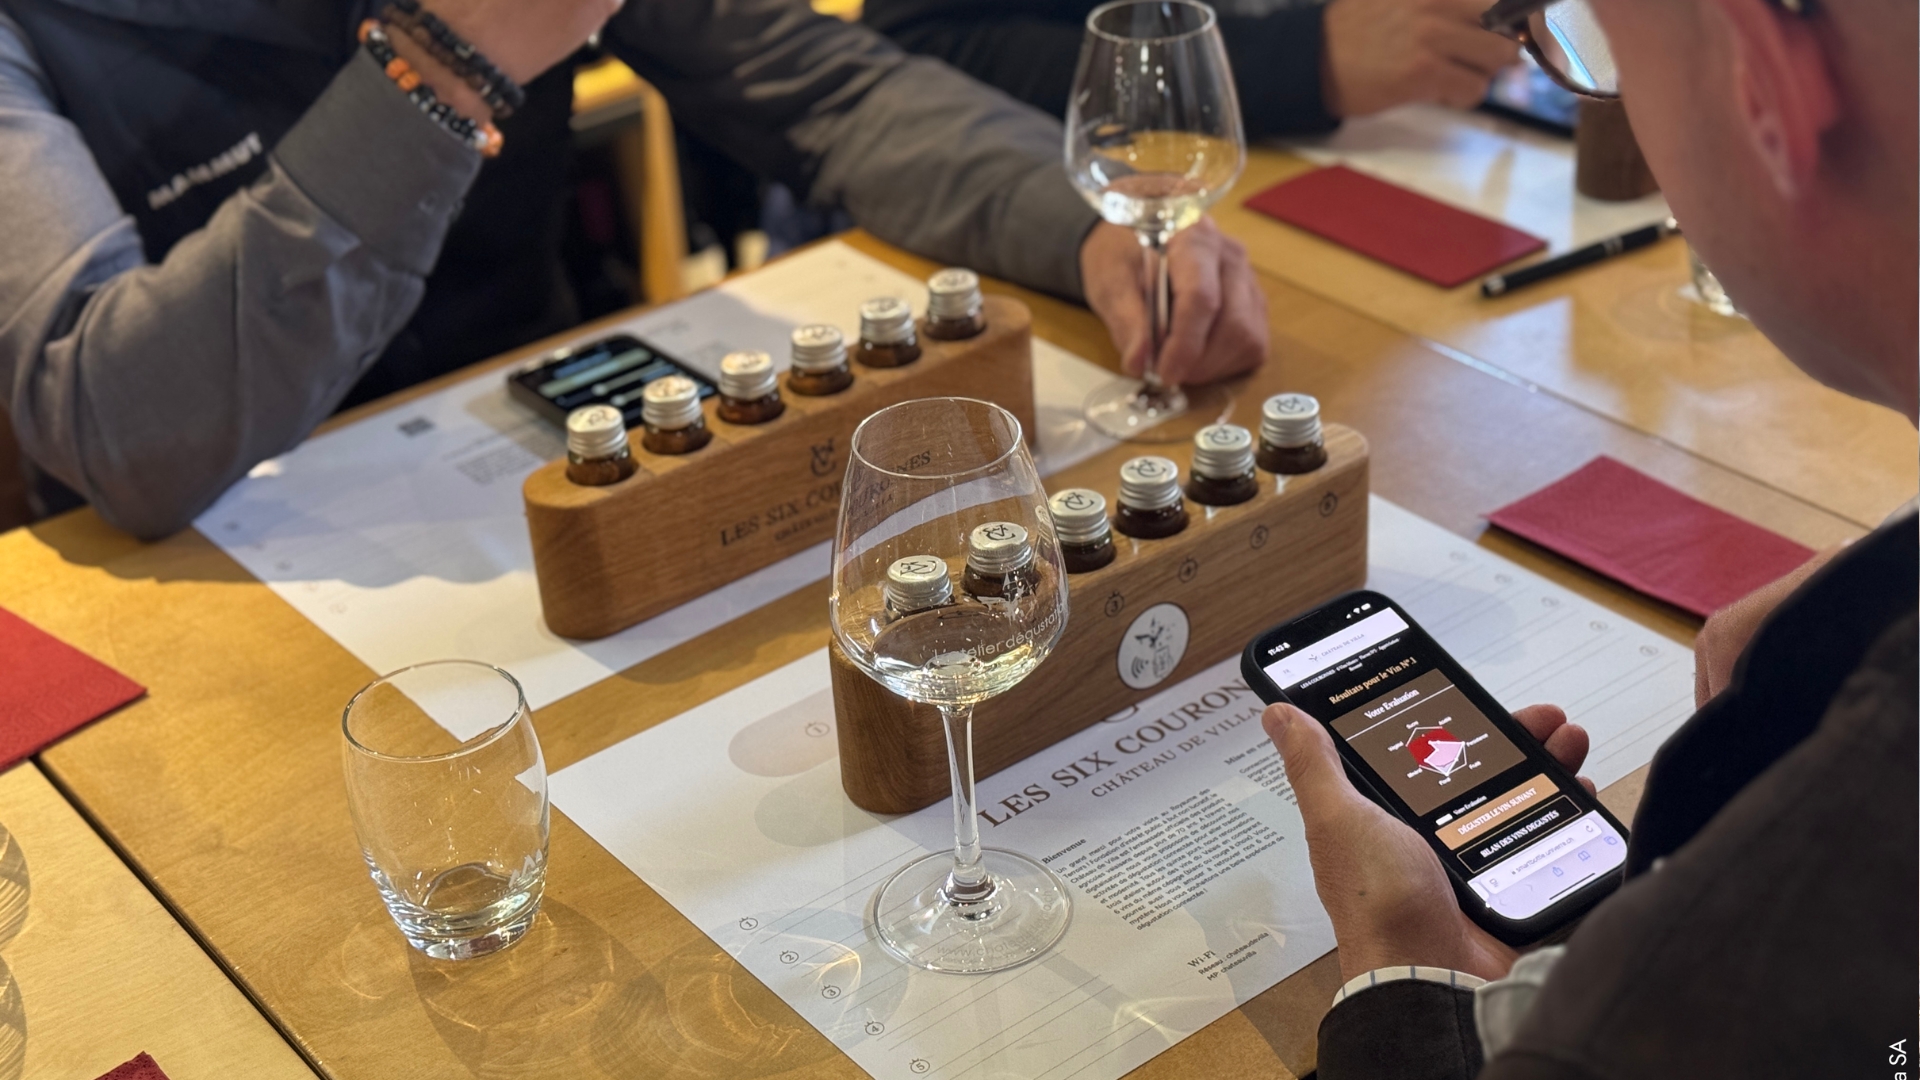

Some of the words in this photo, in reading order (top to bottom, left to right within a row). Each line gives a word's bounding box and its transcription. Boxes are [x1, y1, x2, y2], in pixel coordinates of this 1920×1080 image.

[720, 513, 761, 547] LES
[764, 500, 800, 529] SIX
[1329, 684, 1363, 704] Résultats
[1362, 675, 1380, 689] pour
[1385, 665, 1402, 674] Vin
[1364, 706, 1385, 718] Votre
[1382, 689, 1419, 710] Evaluation
[1091, 750, 1176, 797] CHÂTEAU
[1177, 735, 1206, 752] DE
[1204, 707, 1262, 735] VILLA
[1256, 737, 1273, 748] rout
[977, 783, 1050, 826] LES
[1051, 751, 1115, 787] SIX
[1457, 812, 1492, 834] DÉGUSTER
[1497, 802, 1511, 812] VIN
[1509, 787, 1536, 806] SUIVANT
[1041, 838, 1086, 864] Bienvenue
[1480, 842, 1501, 857] BILAN
[1498, 835, 1513, 847] DES
[1510, 827, 1528, 839] VINS
[1187, 950, 1216, 966] Wi-Fi
